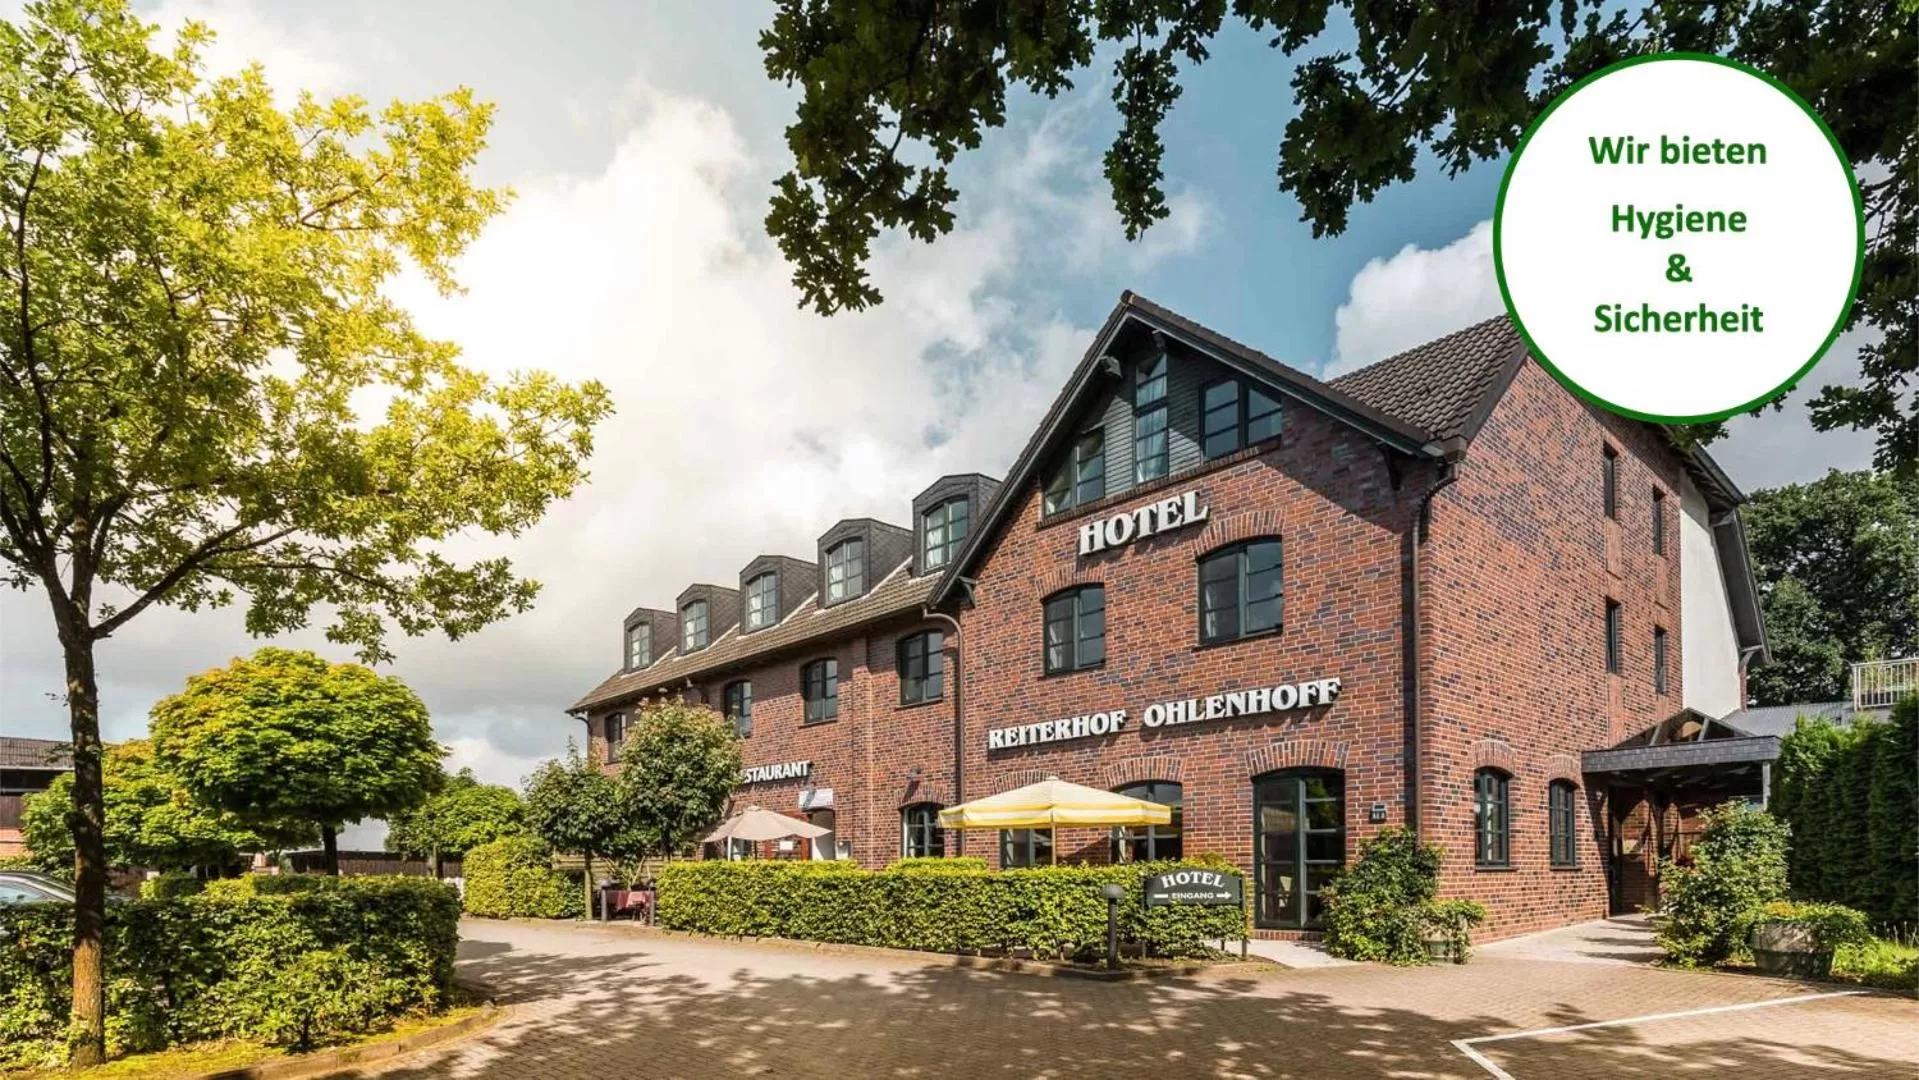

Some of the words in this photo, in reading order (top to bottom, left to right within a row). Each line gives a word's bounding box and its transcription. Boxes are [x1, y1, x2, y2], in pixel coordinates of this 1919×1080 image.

[1079, 490, 1208, 555] HOTEL
[988, 709, 1127, 749] REITERHOF
[1144, 677, 1341, 728] OHLENHOFF
[741, 761, 810, 783] STAURANT
[1161, 871, 1225, 888] HOTEL
[1171, 892, 1214, 900] EINGANG
